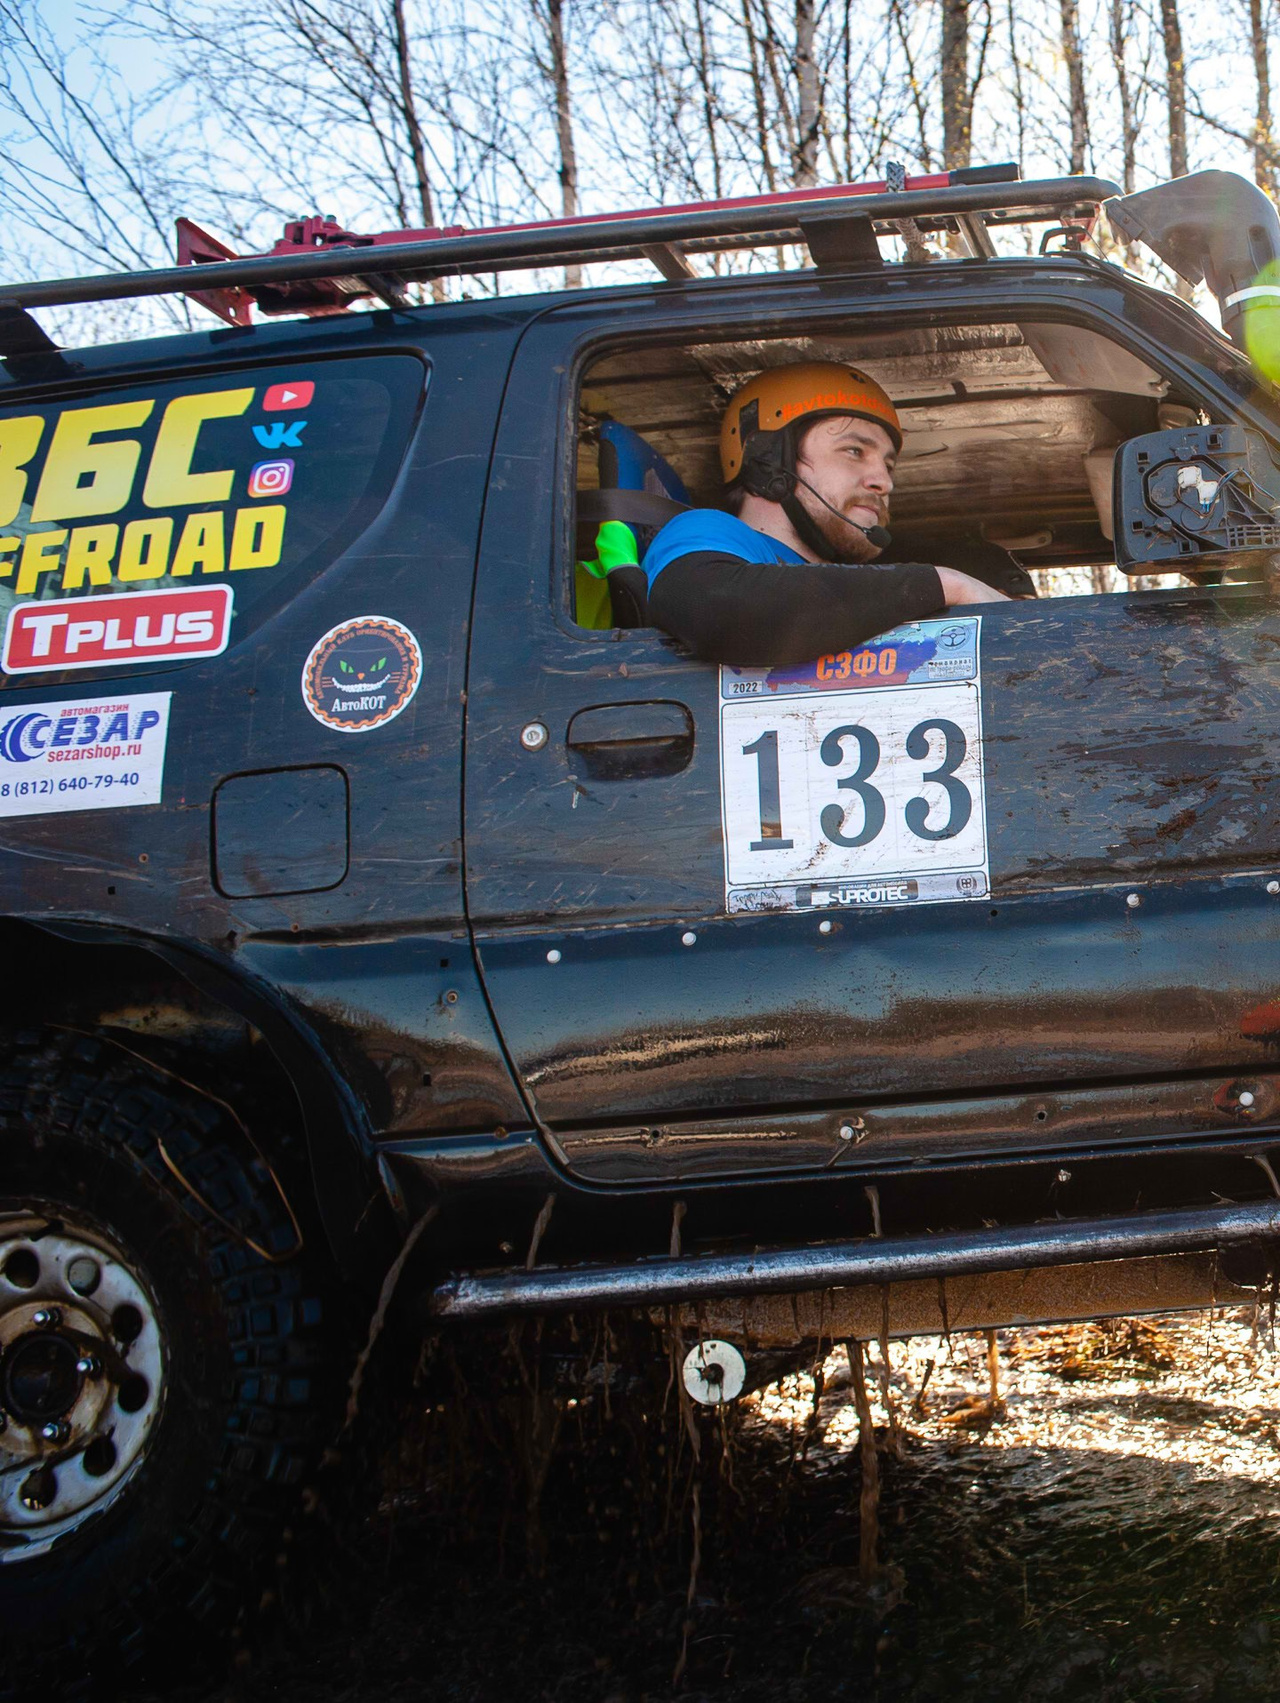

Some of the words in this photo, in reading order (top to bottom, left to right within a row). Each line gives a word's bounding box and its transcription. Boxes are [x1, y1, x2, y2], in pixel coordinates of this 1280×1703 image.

[816, 648, 897, 681] СЗФО
[732, 681, 759, 694] 2022
[60, 703, 130, 717] автомагазин
[26, 710, 160, 749] СЕЗАР
[47, 743, 142, 763] sezarshop.ru
[1, 783, 11, 797] 8
[14, 778, 54, 798] (812)
[58, 772, 140, 792] 640-79-40
[742, 718, 972, 852] 133
[829, 885, 909, 904] SUPROTEC
